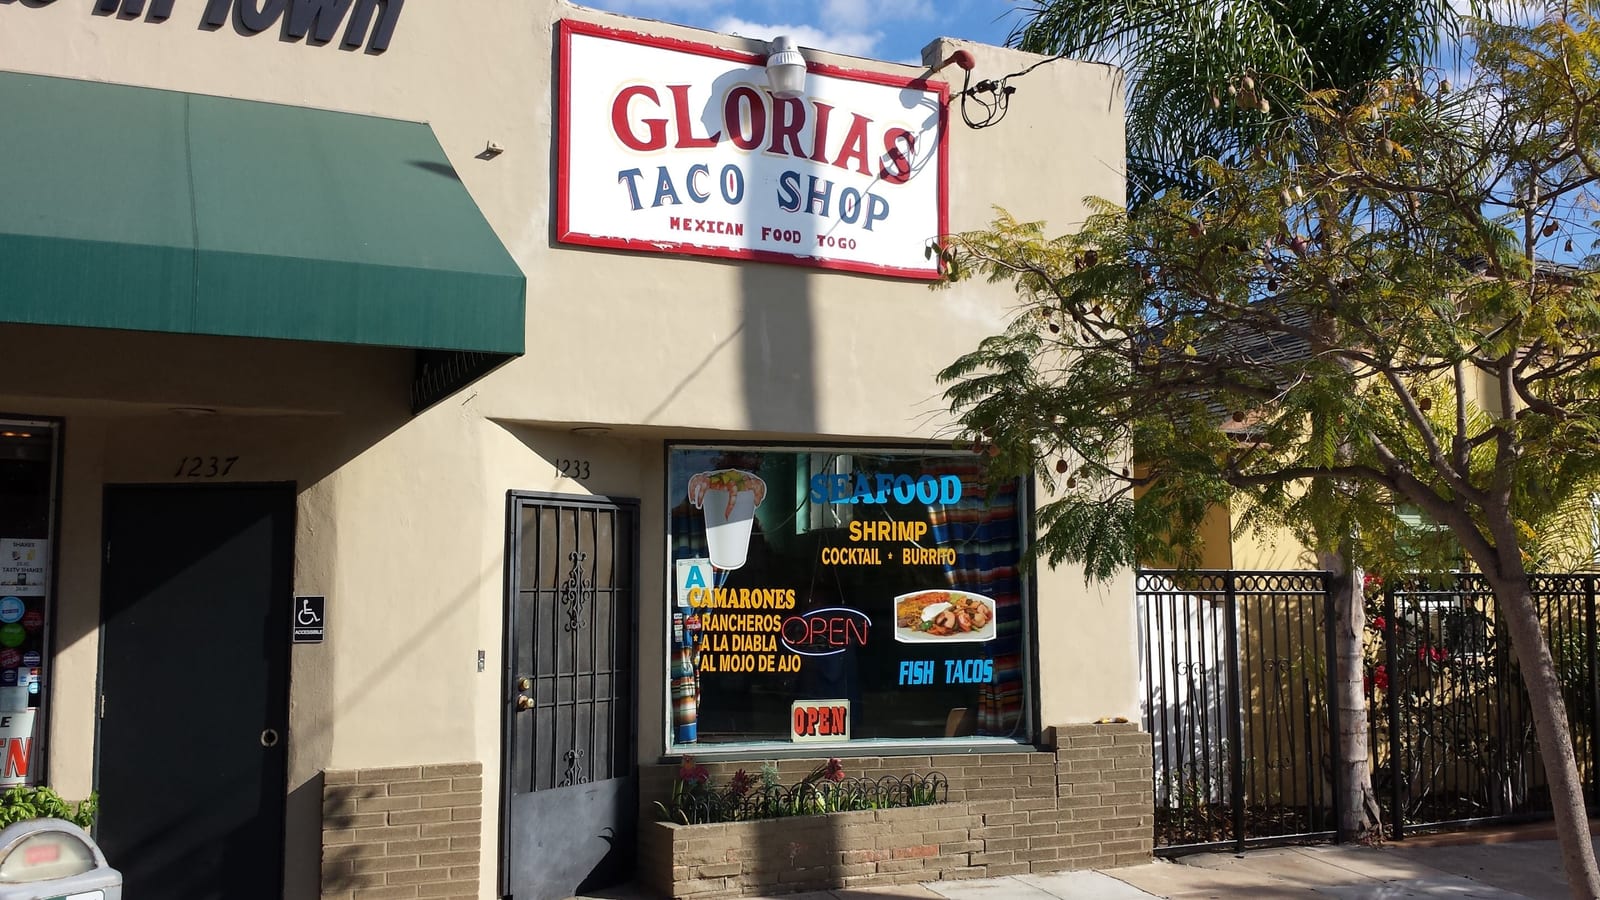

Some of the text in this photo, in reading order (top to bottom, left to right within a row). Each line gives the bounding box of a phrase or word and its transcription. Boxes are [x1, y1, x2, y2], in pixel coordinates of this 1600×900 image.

[612, 85, 916, 185] GLORIAS
[618, 164, 889, 231] TACO SHOP
[670, 216, 744, 236] MEXICAN
[762, 226, 802, 243] FOOD
[174, 456, 239, 478] 1237
[554, 459, 590, 479] 1233
[810, 474, 962, 505] SEAFOOD
[849, 520, 928, 541] SHRIMP
[822, 547, 956, 566] COCKTAIL BURRITO
[685, 565, 706, 589] A
[689, 587, 796, 609] CAMARONES
[702, 614, 782, 632] RANCHEROS
[781, 616, 868, 646] OPEN
[701, 634, 777, 651] A LA DIABLA
[701, 654, 801, 672] AL MOJO DE AJO
[899, 659, 993, 685] FISH TACOS
[793, 706, 847, 737] OPEN
